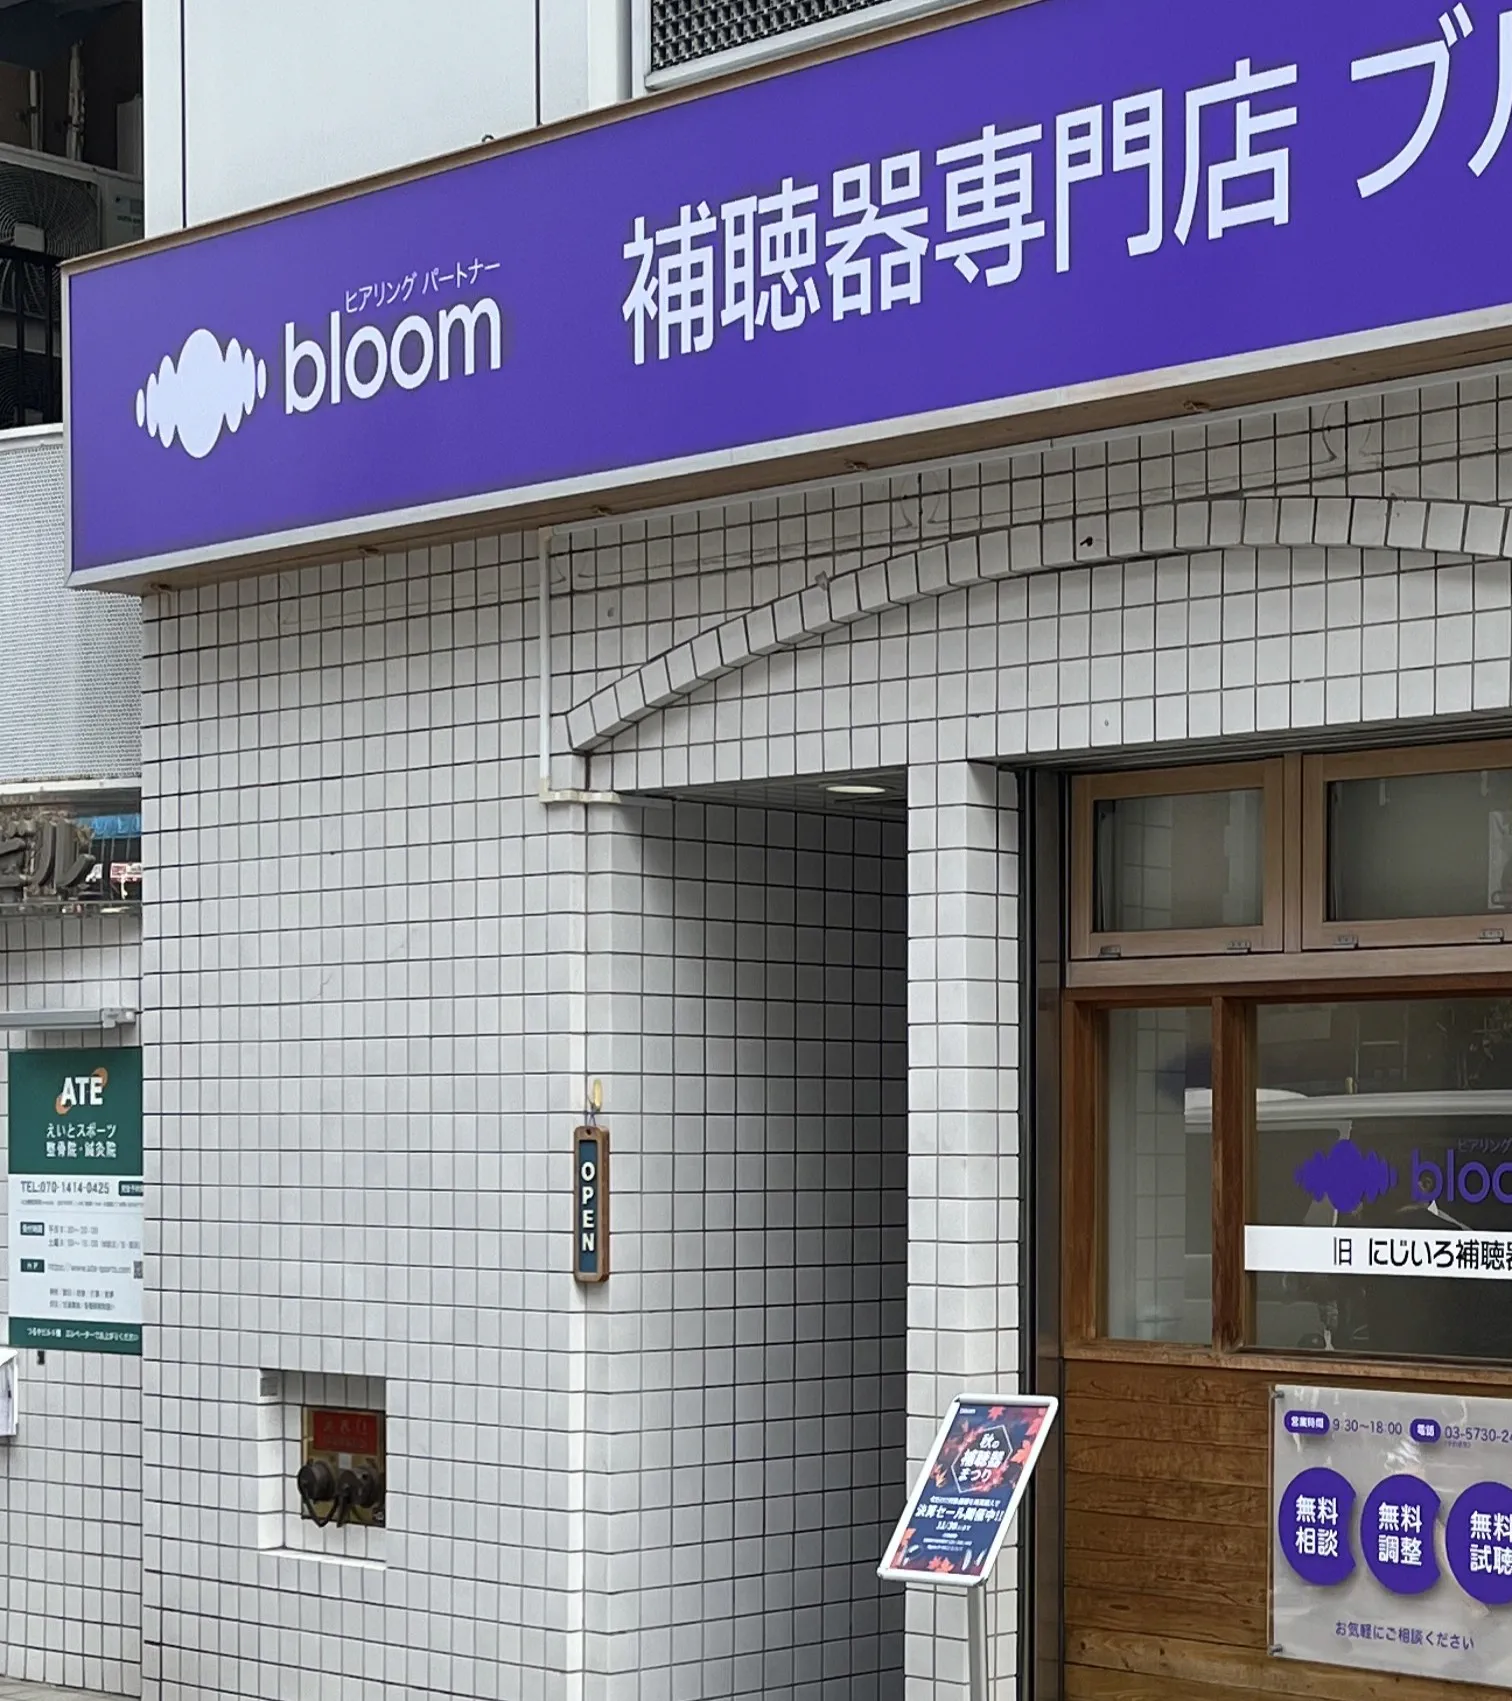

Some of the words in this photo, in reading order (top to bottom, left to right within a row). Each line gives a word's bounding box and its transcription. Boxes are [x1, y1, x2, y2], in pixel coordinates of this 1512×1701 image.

[622, 57, 1298, 366] 補聴器専門店
[344, 271, 418, 315] ヒアリング
[421, 259, 501, 294] パートナー
[283, 294, 502, 415] bloom
[61, 1077, 103, 1105] ATE
[46, 1122, 117, 1138] えいとスポーツ
[1457, 1138, 1512, 1154] ヒアリング
[581, 1162, 595, 1251] OPEN
[1333, 1238, 1352, 1266] 旧
[979, 1433, 999, 1449] 秋の
[1291, 1416, 1324, 1429] 営業時間
[1417, 1424, 1435, 1437] 電話
[958, 1468, 992, 1483] まつり
[1296, 1495, 1338, 1525] 無料
[1378, 1502, 1422, 1533] 無料
[1295, 1528, 1338, 1558] 相談
[1378, 1536, 1422, 1567] 調整
[1335, 1620, 1475, 1651] お気軽にご相談ください
